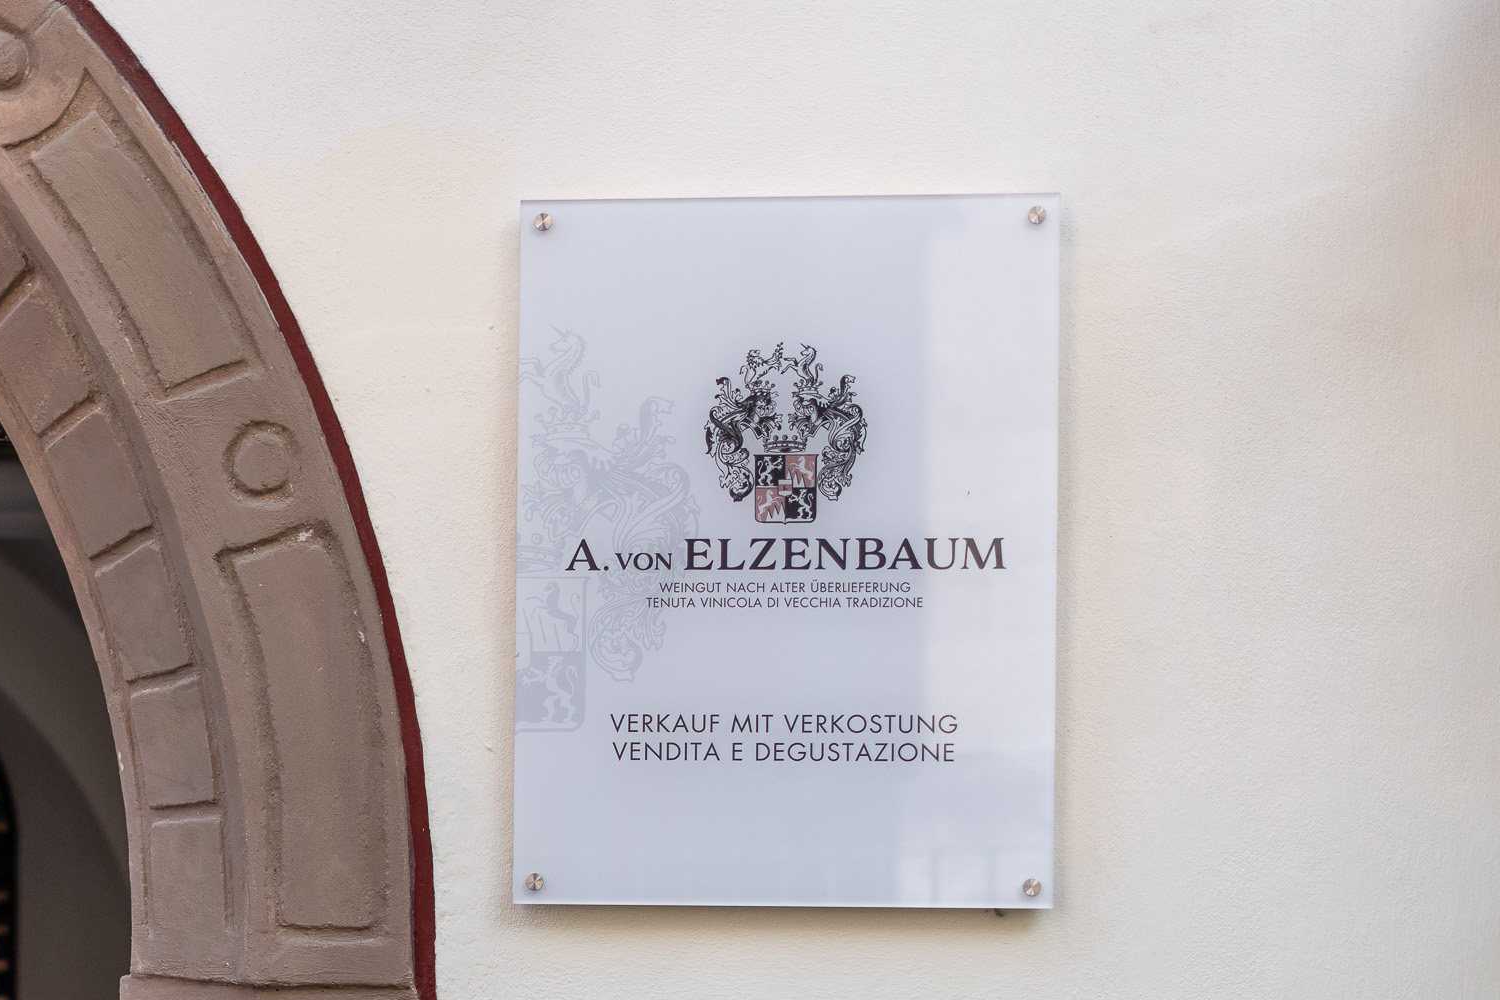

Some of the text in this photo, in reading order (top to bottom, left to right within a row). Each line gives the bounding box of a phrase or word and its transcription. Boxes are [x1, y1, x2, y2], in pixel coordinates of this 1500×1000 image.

[565, 537, 1007, 571] A. VON ELZENBAUM
[658, 578, 911, 594] WEINGUT NACH ALTER ÜBERLIEFERUNG
[645, 596, 924, 609] TENUTA VINICOLA DI VECCHIA TRADIZIONE
[609, 713, 958, 735] VERKAUF MIT VERKOSTUNG
[611, 741, 955, 763] VENDITA E DEGUSTAZIONE
